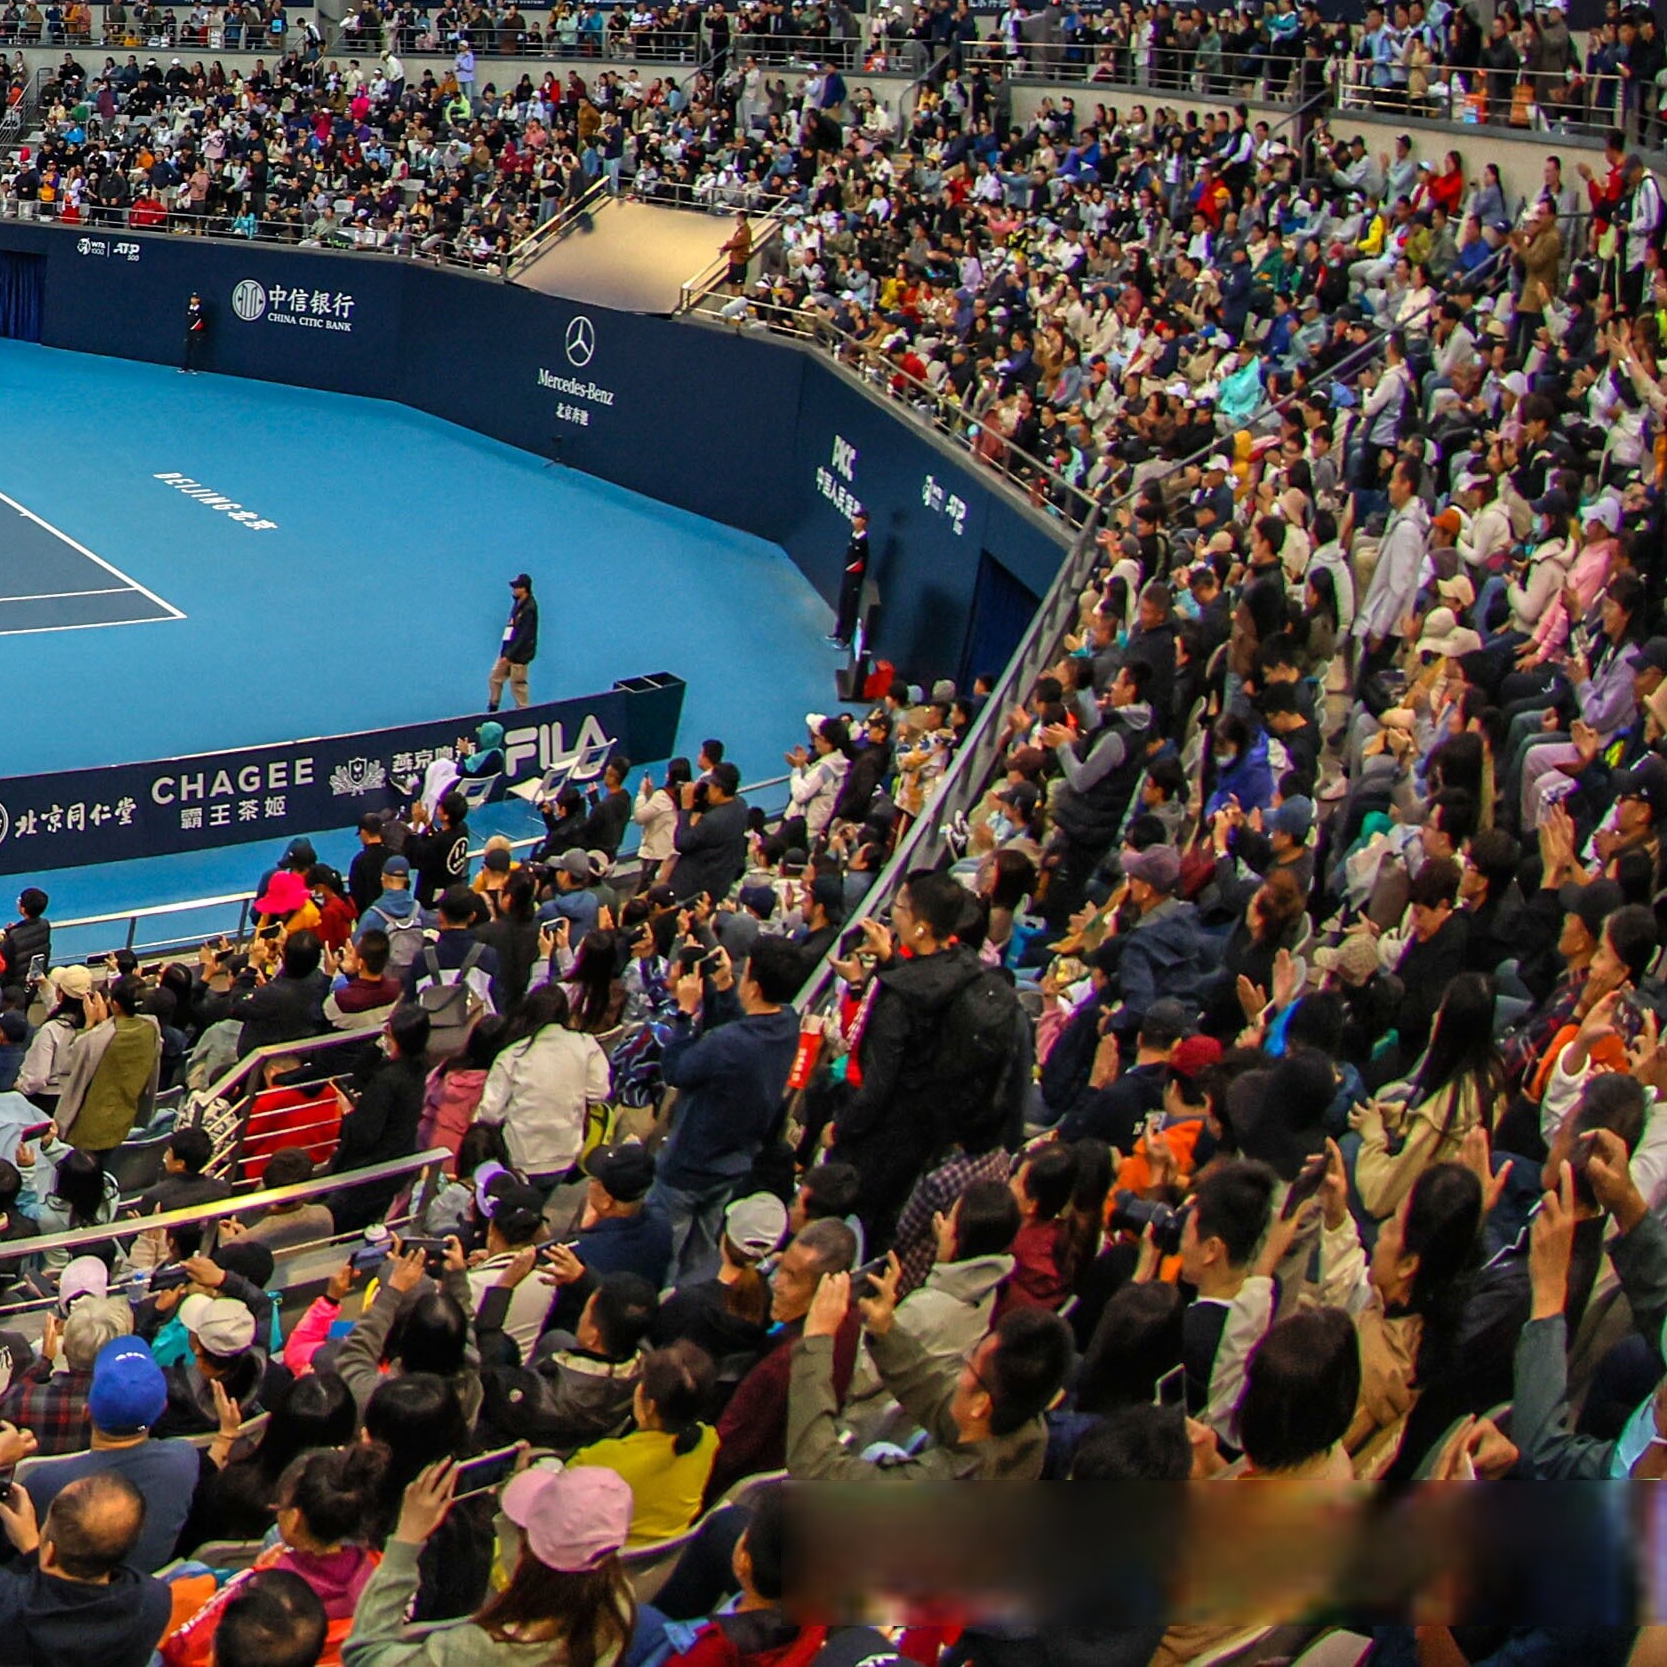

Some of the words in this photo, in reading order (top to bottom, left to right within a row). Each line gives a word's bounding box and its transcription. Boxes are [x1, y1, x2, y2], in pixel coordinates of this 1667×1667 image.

[91, 241, 106, 249] WTA
[113, 242, 140, 255] ATP
[268, 284, 355, 319] 中信银行
[268, 311, 297, 324] CHINA
[299, 314, 323, 328] CITIC
[325, 318, 352, 332] BANK
[538, 367, 615, 406] Mercedes-Benz
[555, 402, 588, 426] 北京奔驰
[831, 434, 857, 482] PICC
[153, 472, 242, 511] BEIJING
[228, 509, 279, 530] 北京
[504, 714, 610, 778] FILA
[151, 757, 315, 805] CHAGEE
[14, 796, 137, 838] 北京同仁堂
[180, 795, 287, 830] 霸王茶姬
